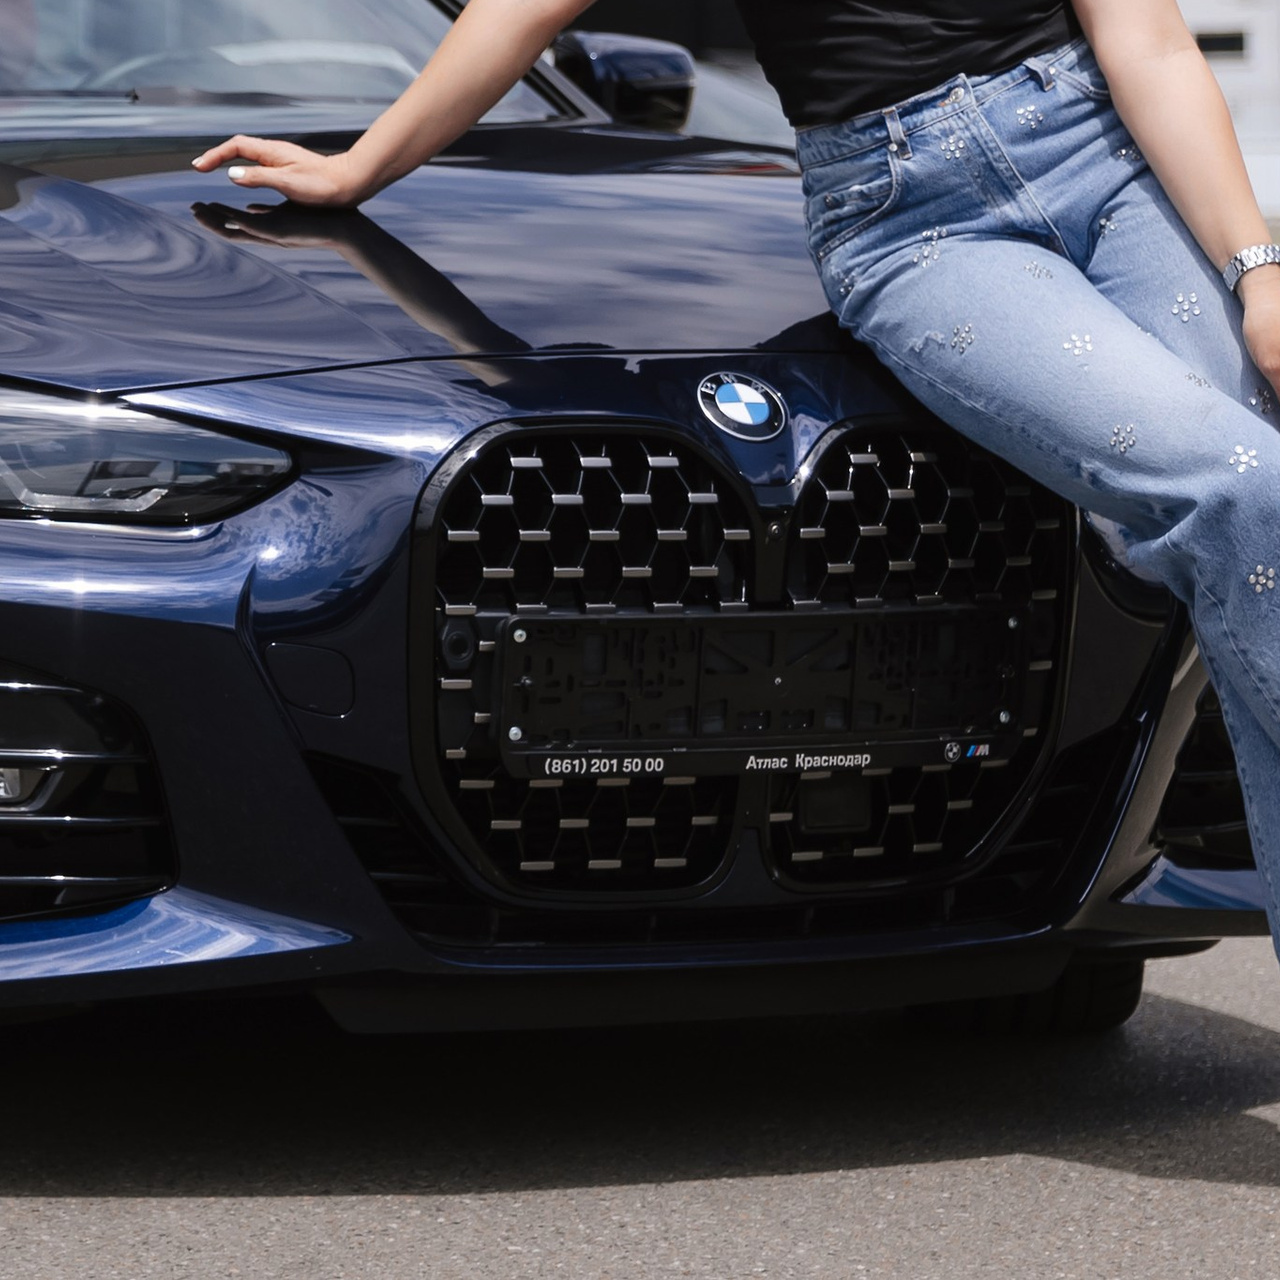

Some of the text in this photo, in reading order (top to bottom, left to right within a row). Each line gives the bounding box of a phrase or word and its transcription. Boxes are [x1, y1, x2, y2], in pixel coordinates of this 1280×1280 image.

[700, 373, 766, 396] BMW
[545, 757, 664, 775] (861) 201 50 00
[745, 753, 871, 771] Атлас Краснодар
